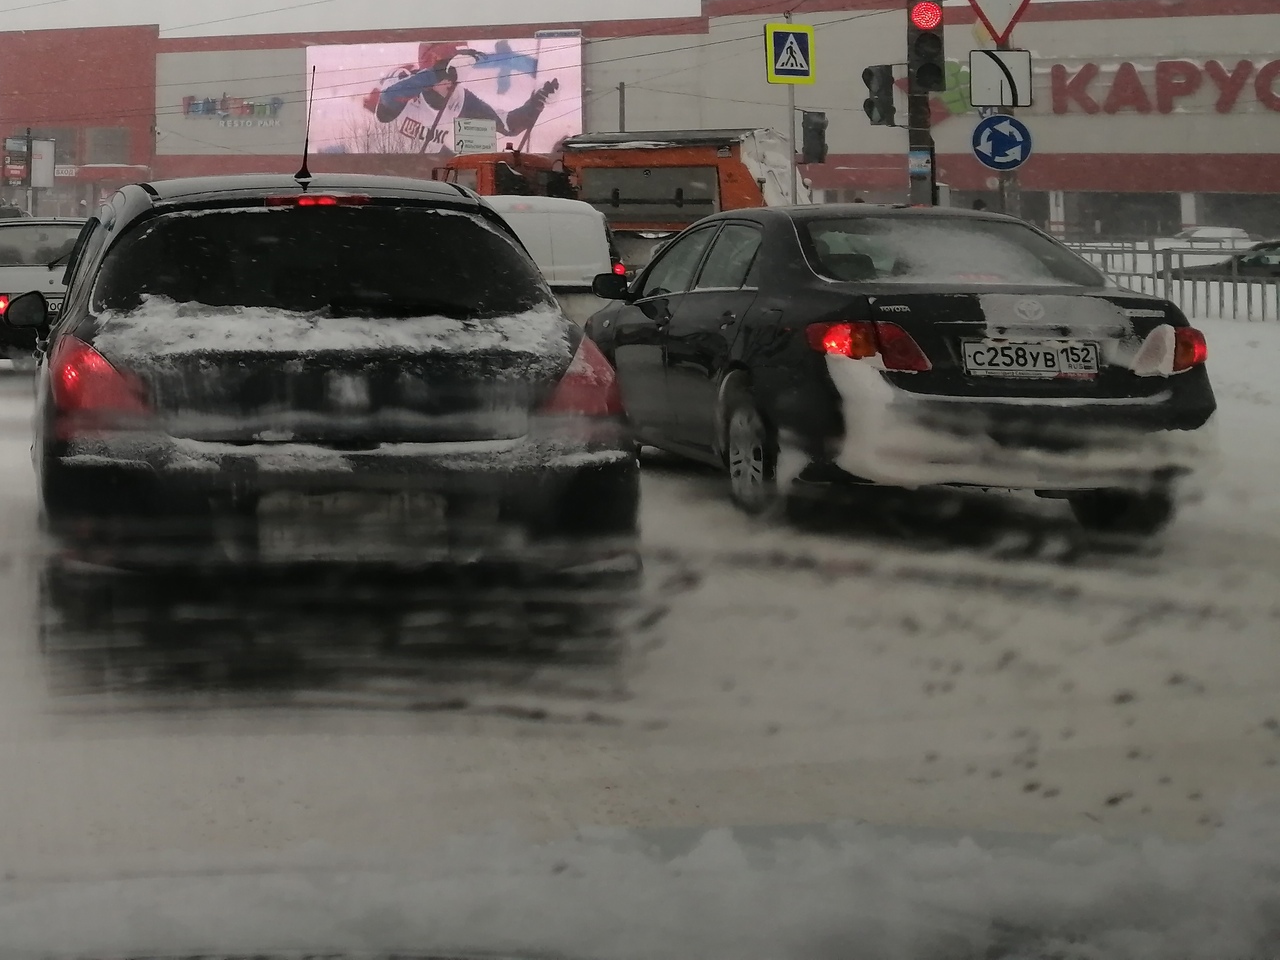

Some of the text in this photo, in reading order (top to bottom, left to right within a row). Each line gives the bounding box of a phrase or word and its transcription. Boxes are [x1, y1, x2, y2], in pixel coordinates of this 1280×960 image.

[219, 119, 281, 128] RESTO PARK
[879, 305, 912, 313] TOYOTA
[972, 346, 1091, 368] С258УВ 152
